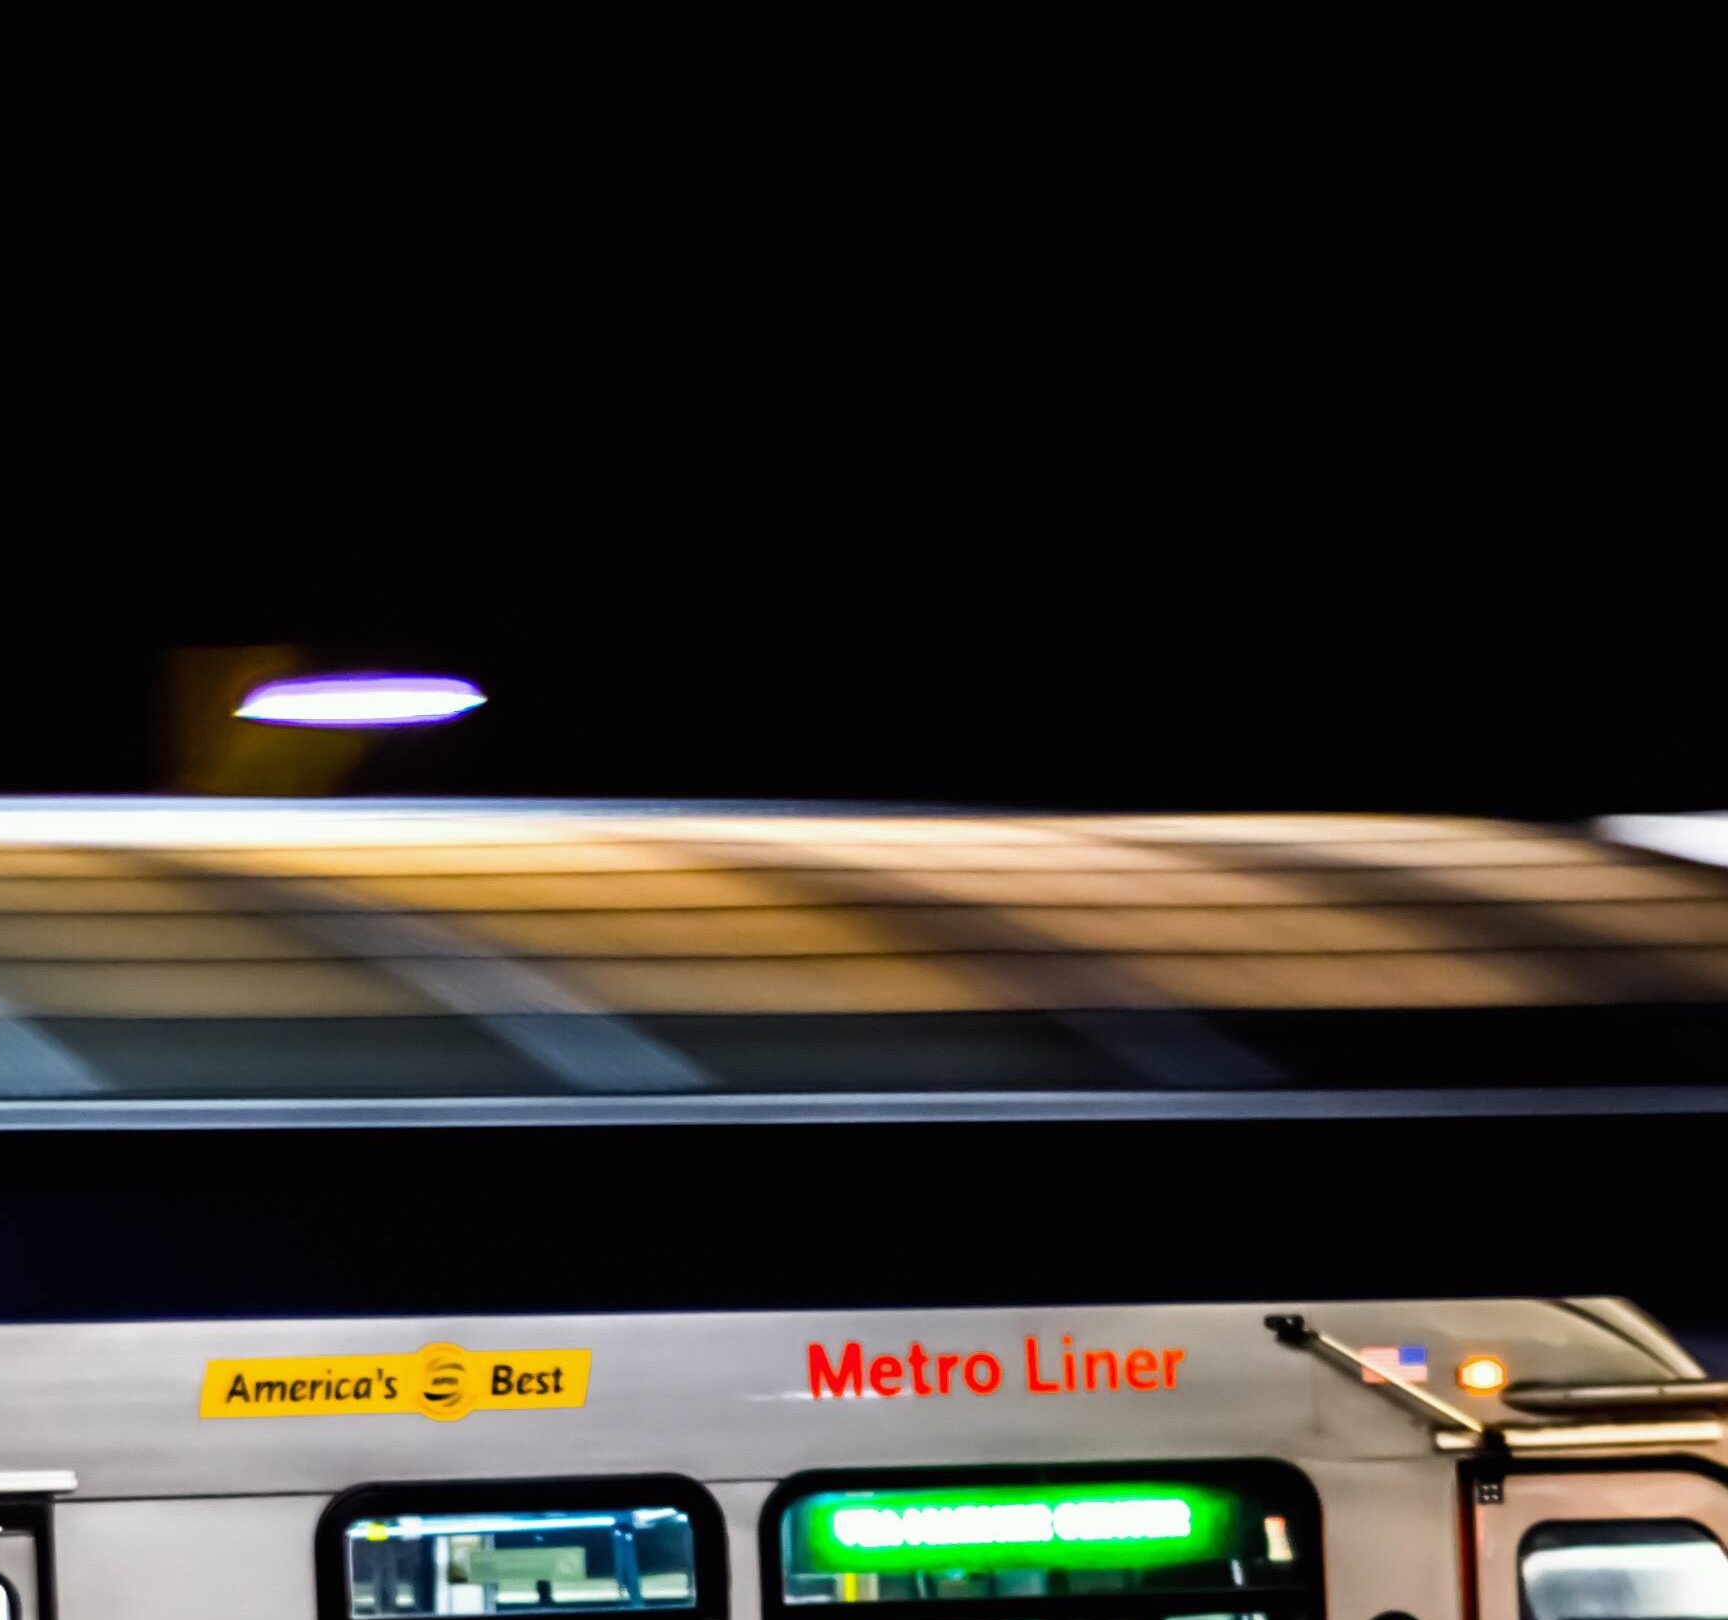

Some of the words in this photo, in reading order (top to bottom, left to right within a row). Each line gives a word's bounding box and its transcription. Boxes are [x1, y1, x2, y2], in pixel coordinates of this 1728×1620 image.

[224, 1367, 399, 1405] America's
[490, 1364, 565, 1396] Best
[806, 1340, 1002, 1399] Metro
[1024, 1335, 1186, 1394] Liner
